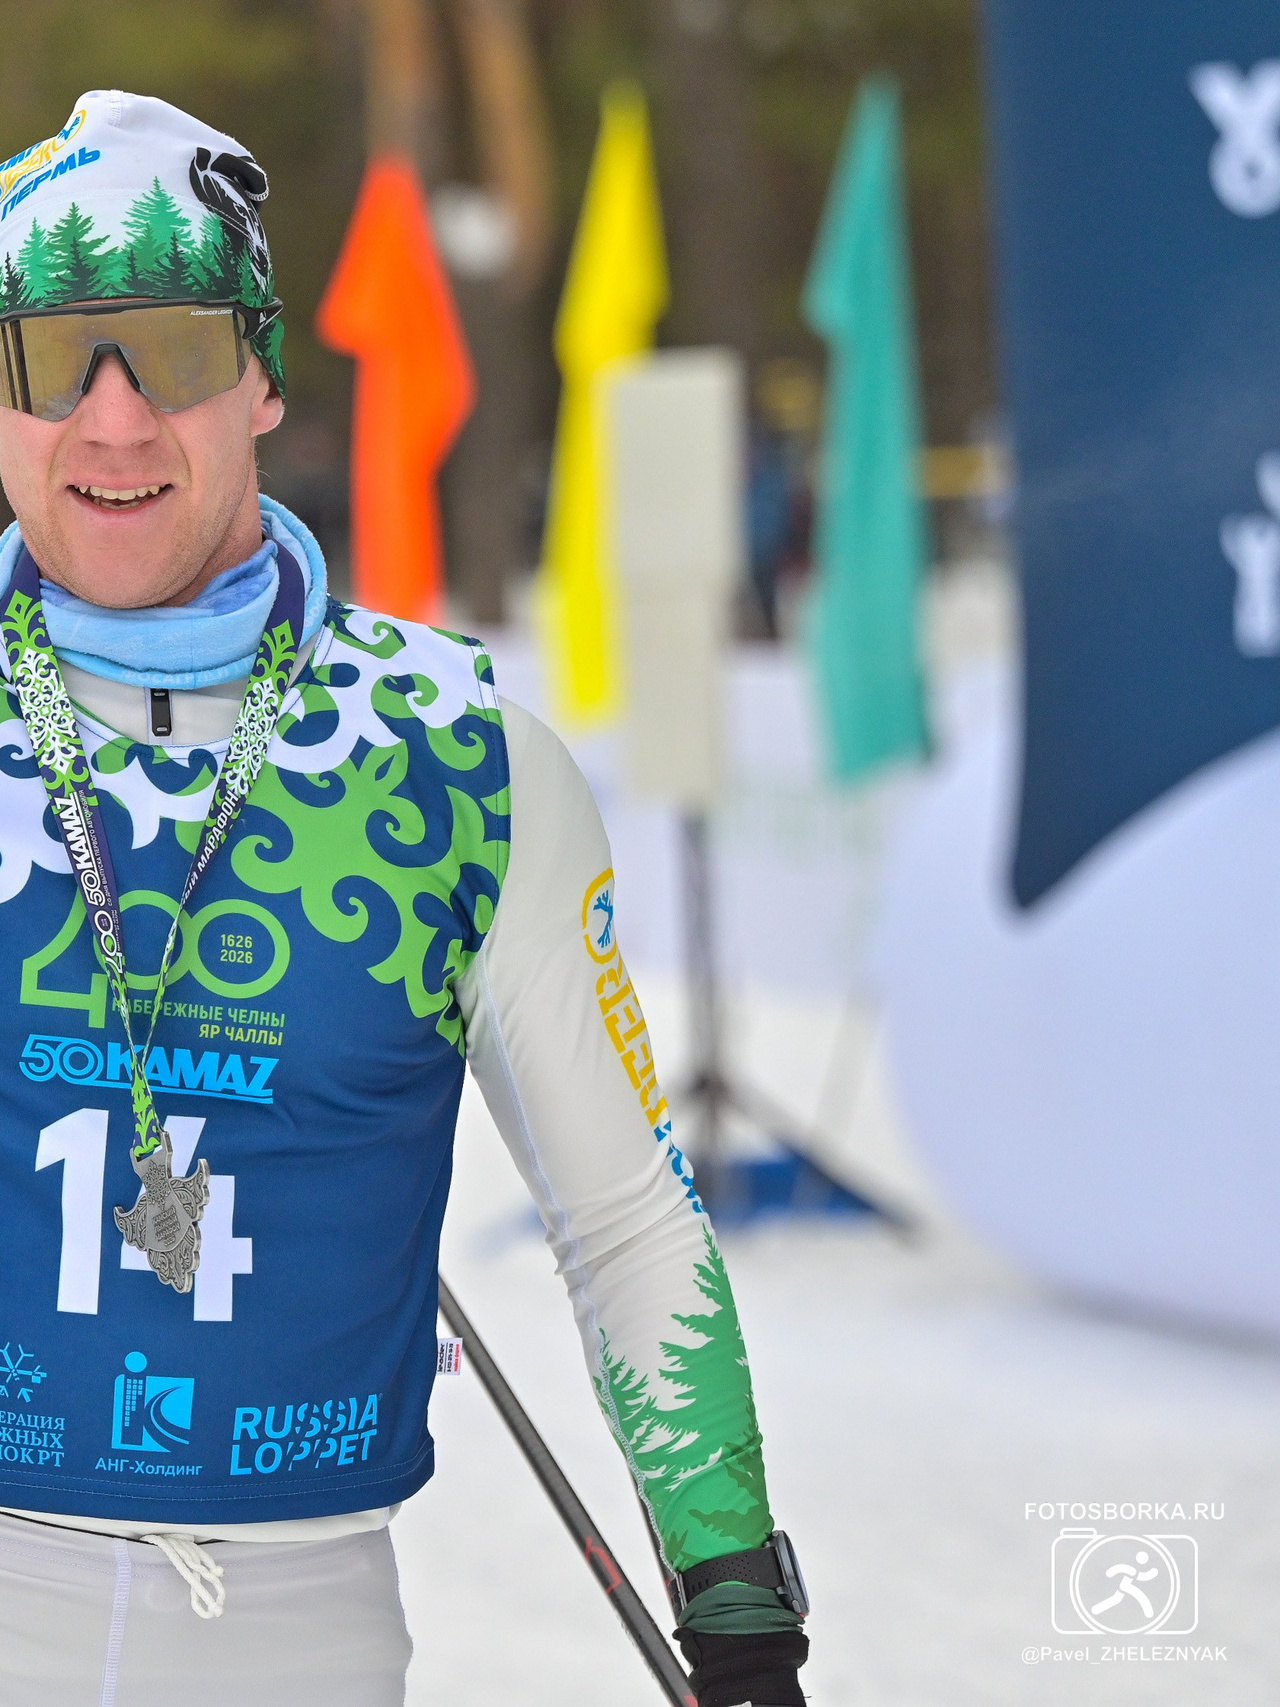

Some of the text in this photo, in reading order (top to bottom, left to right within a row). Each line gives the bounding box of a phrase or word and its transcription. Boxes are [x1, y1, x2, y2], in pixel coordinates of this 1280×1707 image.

[1, 147, 100, 222] ПЕРМЬ
[90, 829, 100, 856] ПЕРВОГО
[197, 790, 239, 872] МАРАФОН
[97, 857, 107, 885] ВЫПУСКА
[220, 934, 253, 949] 1626
[220, 950, 253, 965] 2026
[112, 999, 285, 1027] НБЕЕЖНЫЕ ЧЕЛНЫ
[199, 1024, 283, 1045] ЯР ЧАЛЛЫ
[35, 1107, 253, 1322] 14
[232, 1394, 378, 1440] RUSSIA
[37, 1450, 65, 1467] РТ
[230, 1429, 377, 1475] LOPPET
[95, 1457, 202, 1478] АНГ-Холдинг
